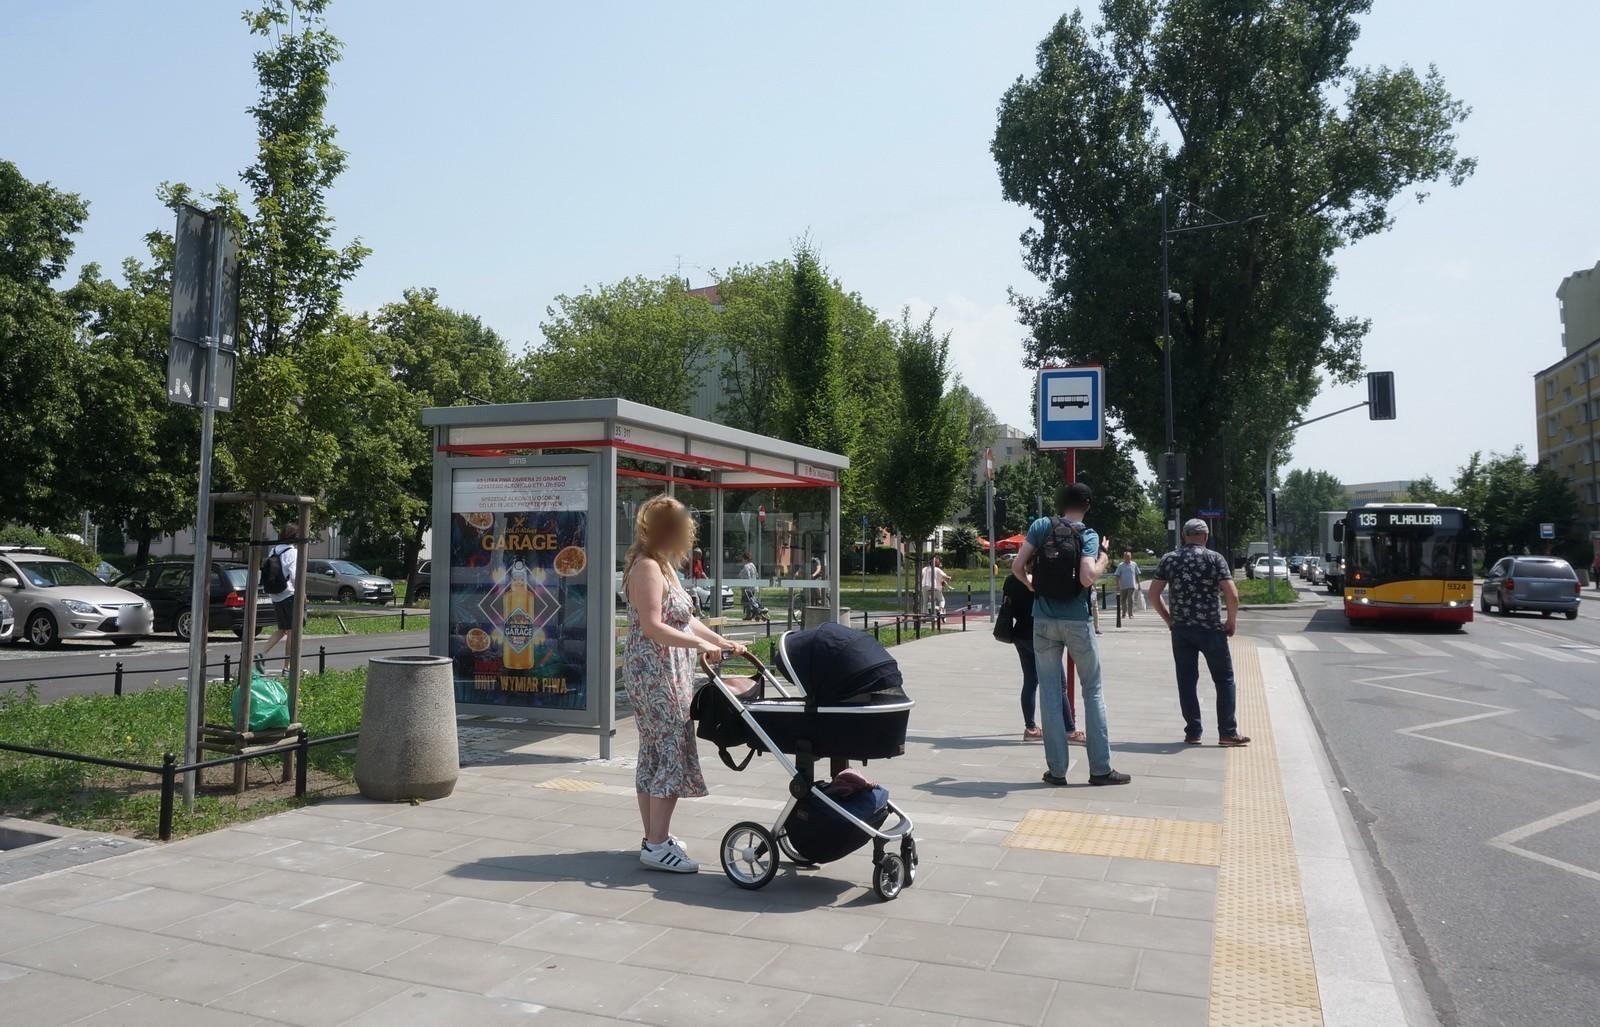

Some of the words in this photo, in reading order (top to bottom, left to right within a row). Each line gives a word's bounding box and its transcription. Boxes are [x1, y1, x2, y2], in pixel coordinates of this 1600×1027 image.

[1359, 513, 1377, 526] 135
[482, 534, 558, 551] GARAGE
[475, 674, 496, 690] INNY
[501, 676, 538, 692] WYMIAR
[543, 678, 567, 694] PIWA
